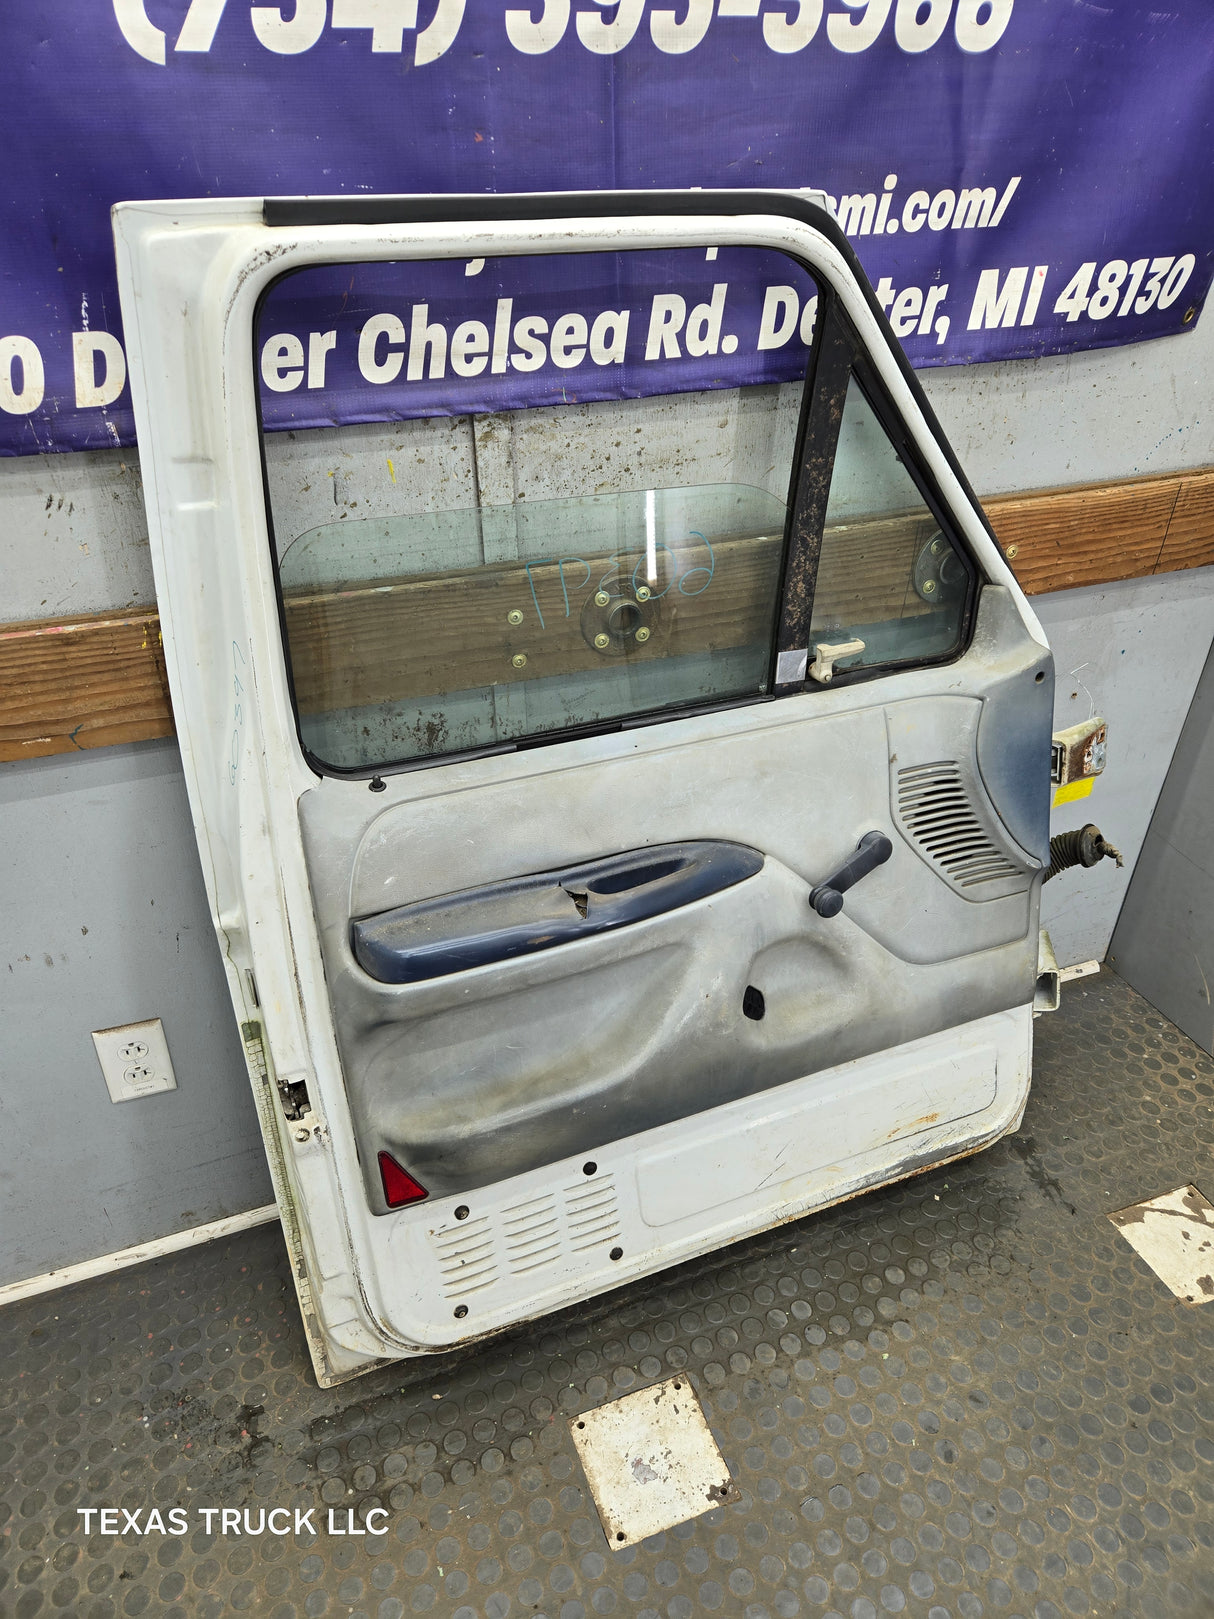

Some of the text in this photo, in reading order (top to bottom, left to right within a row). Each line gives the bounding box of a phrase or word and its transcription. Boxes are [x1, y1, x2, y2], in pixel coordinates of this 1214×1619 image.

[357, 298, 631, 383] Chelsea
[645, 283, 738, 361] Rd.
[966, 265, 1048, 331] MI
[1053, 253, 1196, 323] 48130
